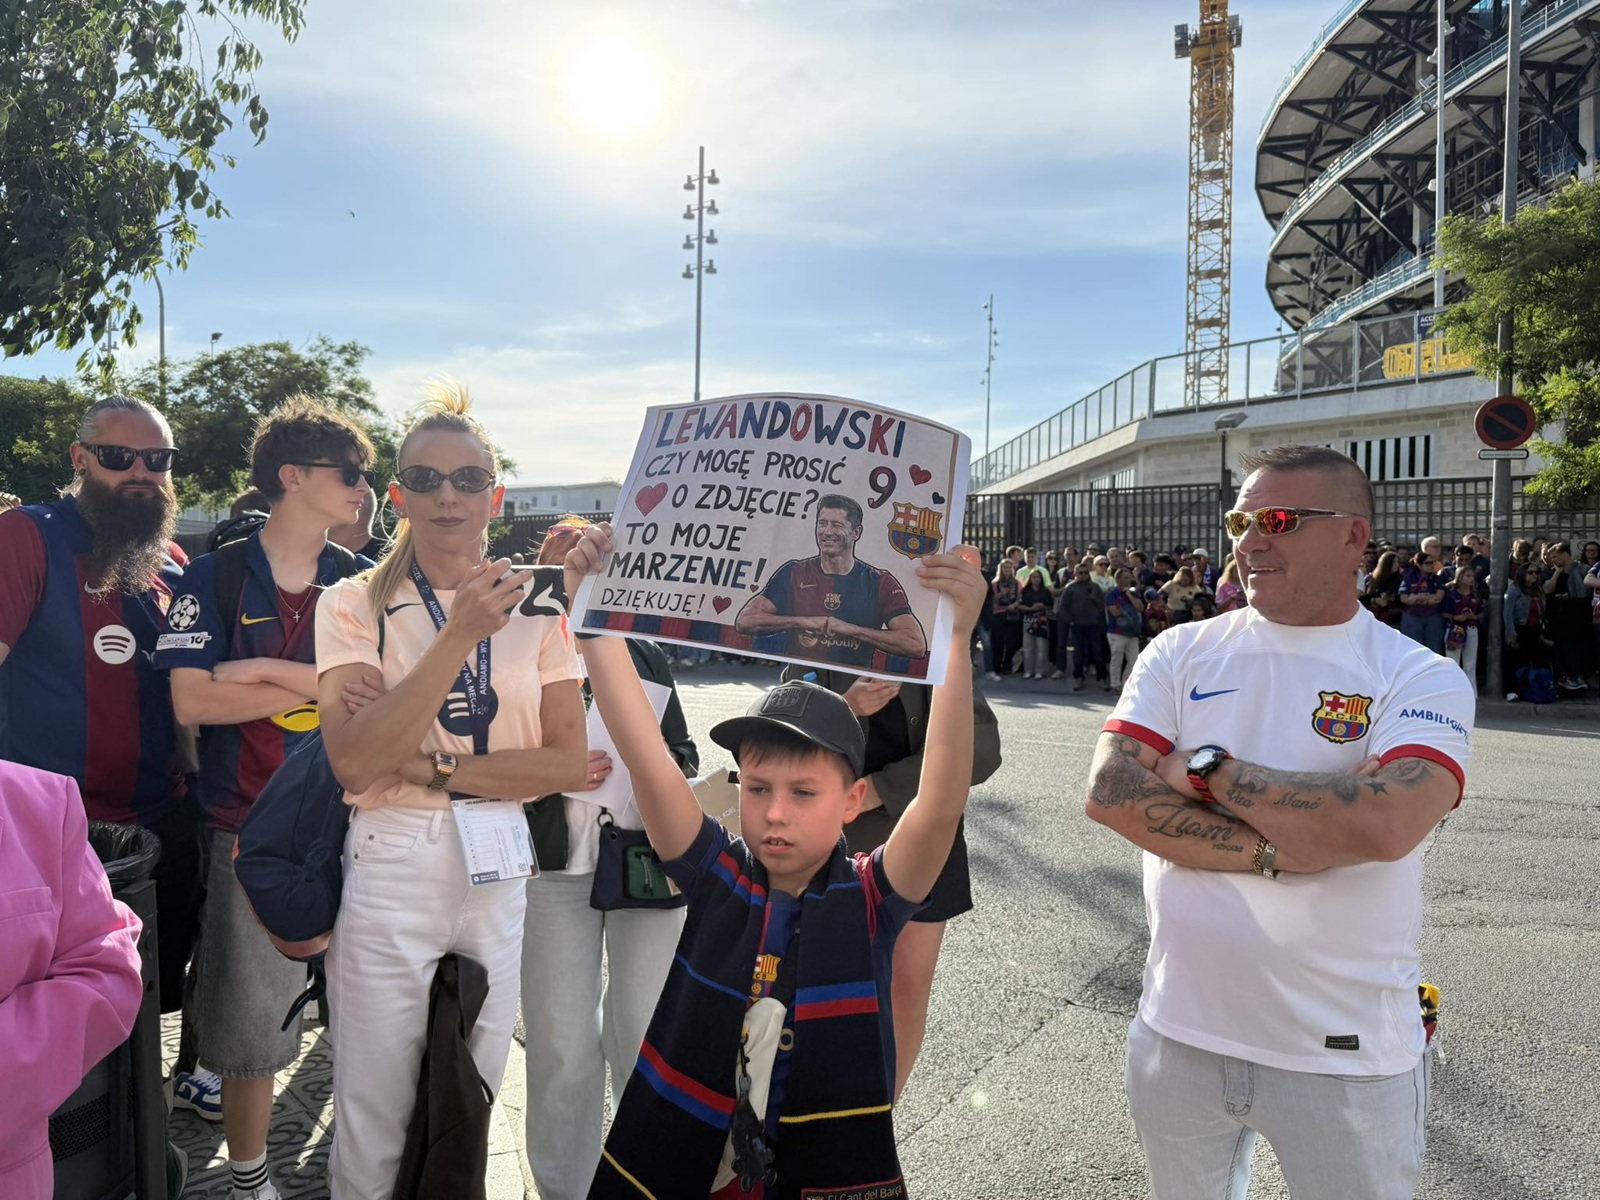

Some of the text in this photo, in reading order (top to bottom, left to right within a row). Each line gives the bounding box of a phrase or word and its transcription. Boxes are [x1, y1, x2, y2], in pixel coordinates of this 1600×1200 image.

[655, 400, 906, 458] LEWANDOWSKI
[645, 449, 848, 485] CZY MOGĘ PROSIĆ
[671, 484, 819, 520] O ZDJĘCIE?
[867, 466, 897, 509] 9
[626, 522, 747, 552] TO MOJE
[607, 552, 767, 591] MARZENIE!
[601, 588, 706, 616] DZIĘKUJĘ!
[480, 659, 488, 695] ANDIAMO
[864, 1189, 878, 1200] del
